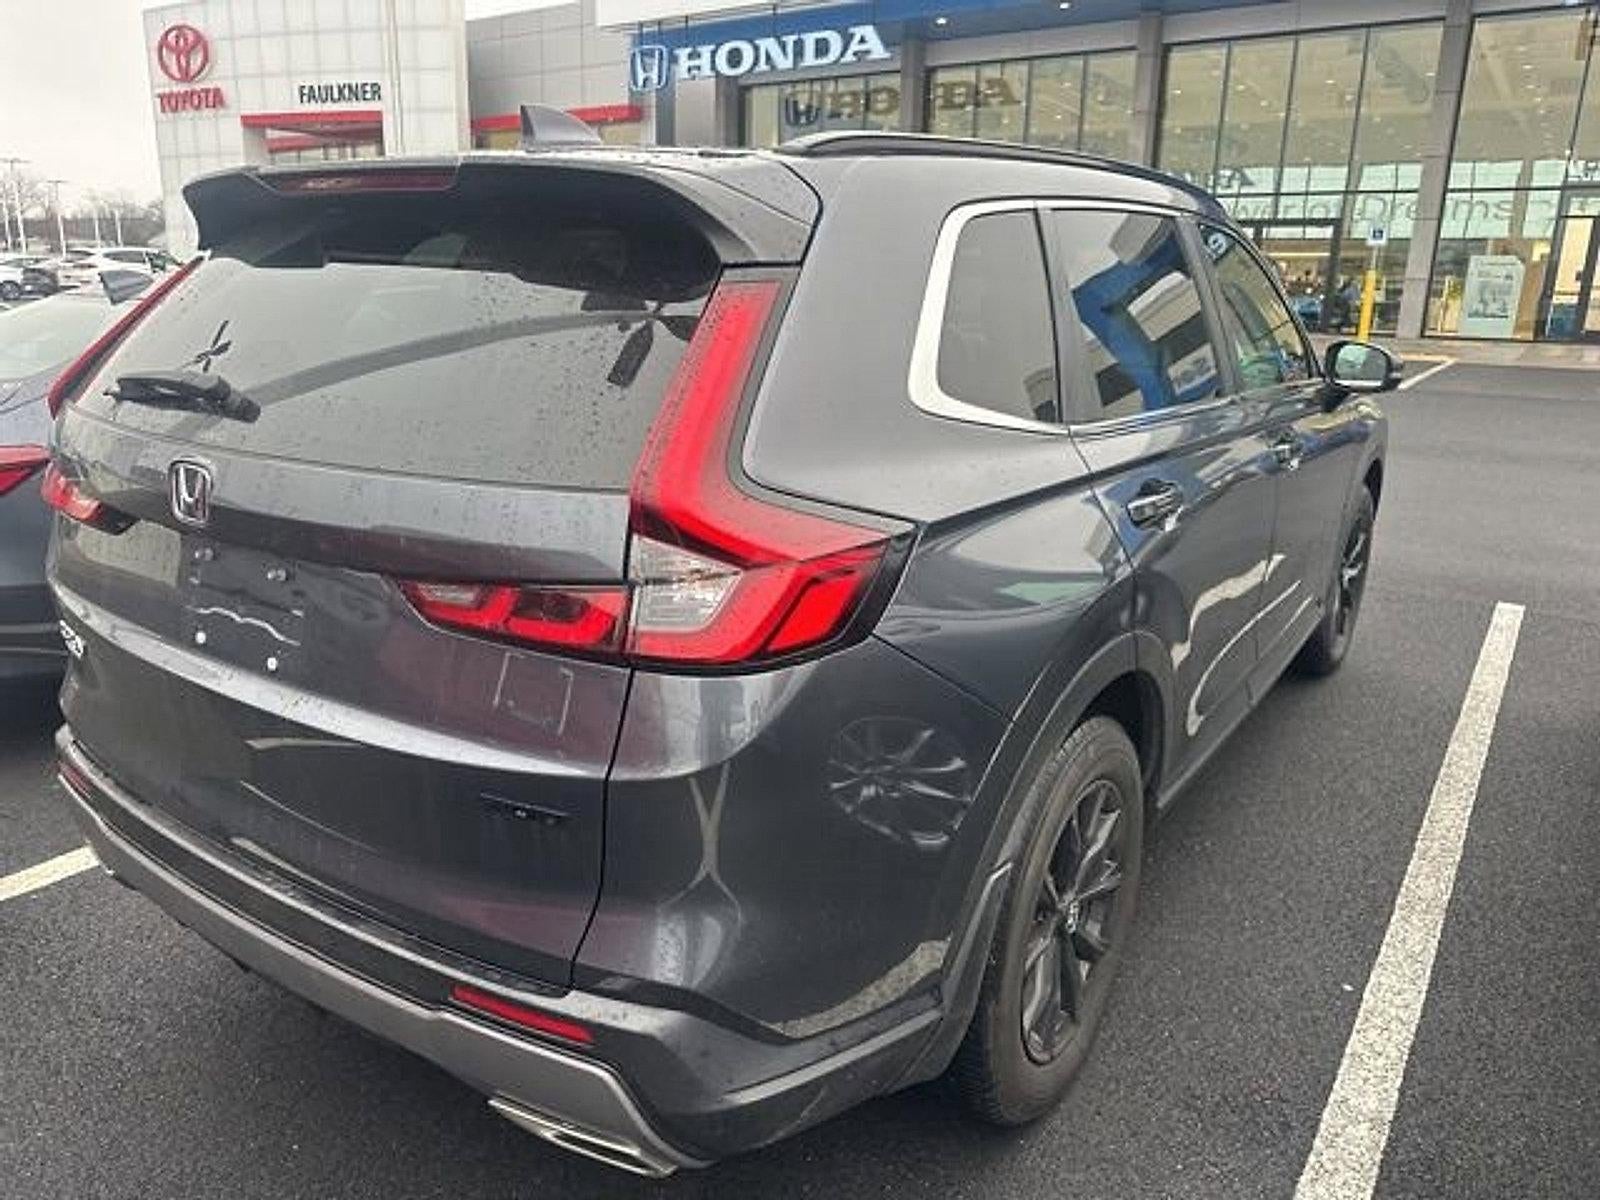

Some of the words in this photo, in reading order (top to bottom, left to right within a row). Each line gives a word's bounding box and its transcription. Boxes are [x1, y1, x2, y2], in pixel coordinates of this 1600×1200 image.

[675, 25, 891, 81] HONDA
[157, 87, 225, 113] TOYOTA
[299, 82, 381, 104] FAULKNER
